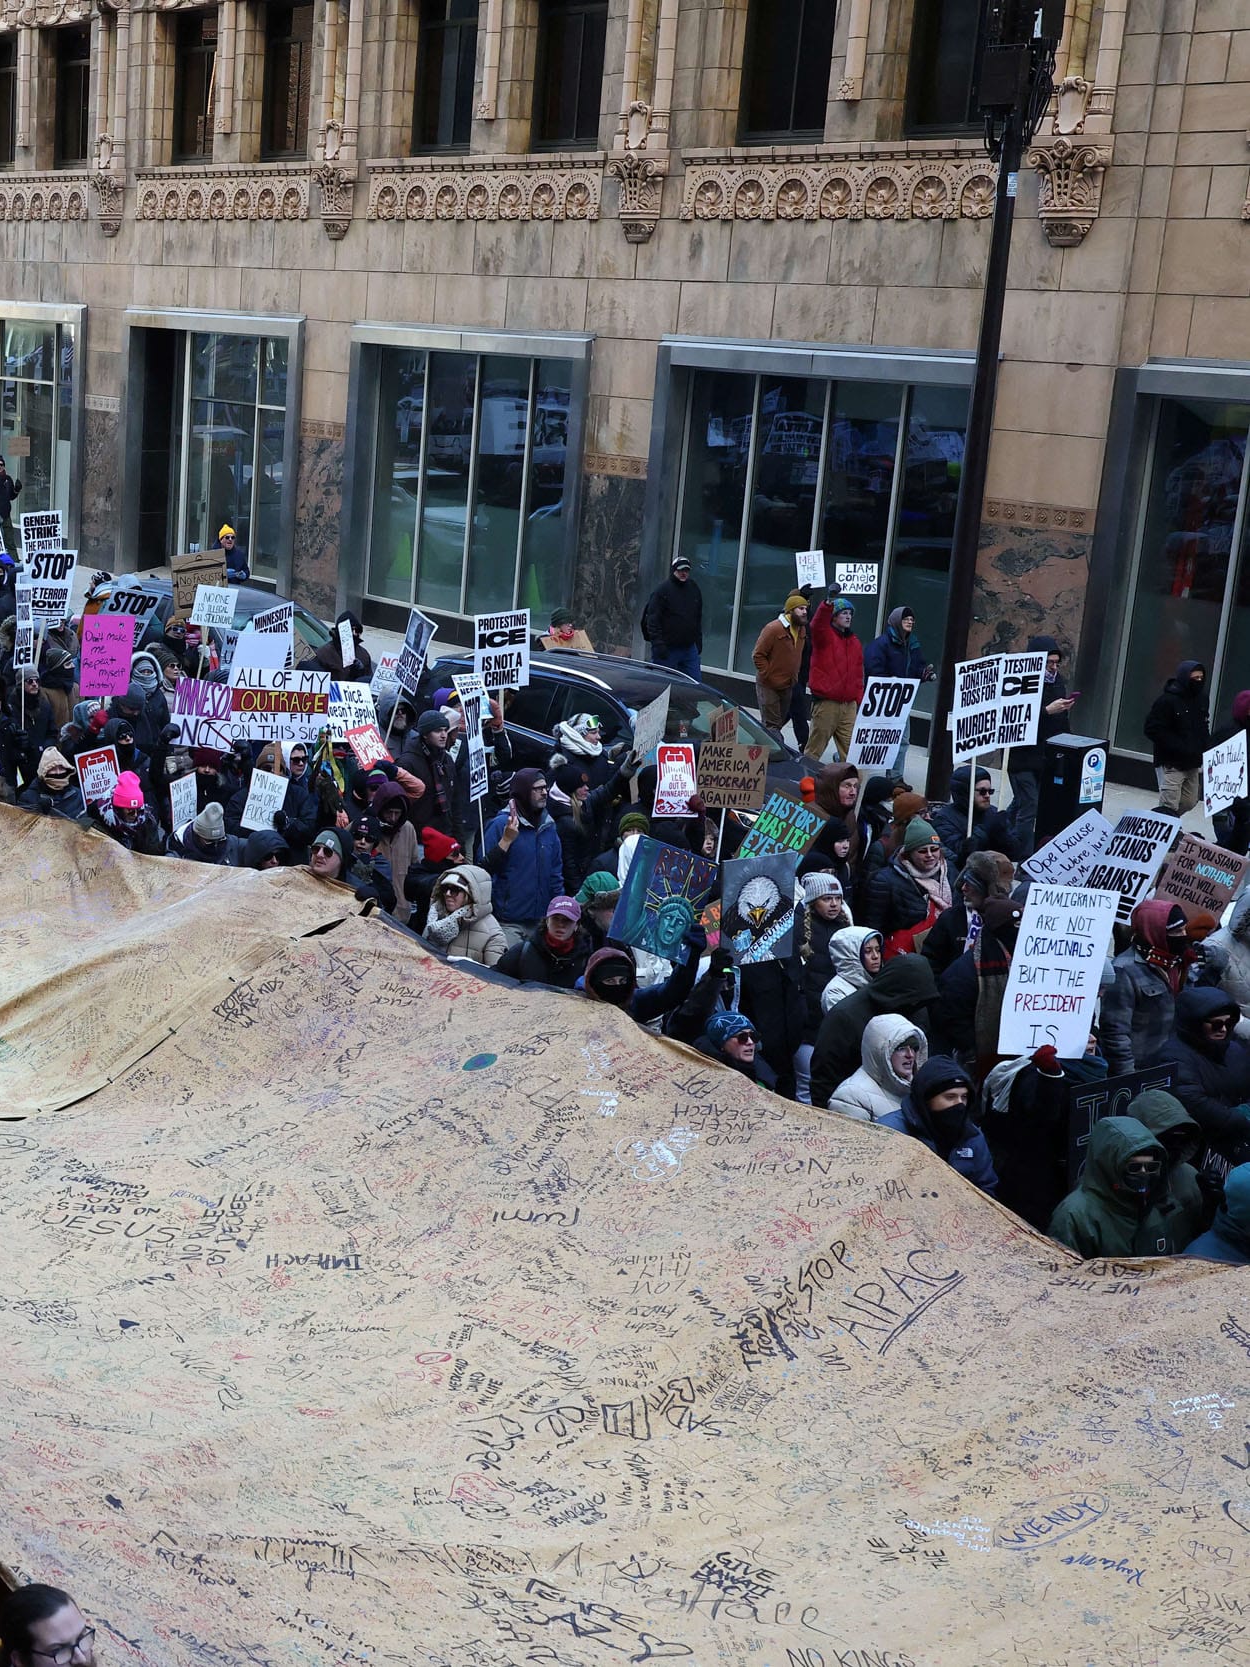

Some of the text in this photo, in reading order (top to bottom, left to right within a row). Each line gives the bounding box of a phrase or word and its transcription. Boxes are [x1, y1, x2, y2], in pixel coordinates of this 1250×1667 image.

[23, 513, 60, 527] GENERAL
[31, 553, 75, 580] STOP
[799, 553, 821, 565] MELT
[846, 564, 874, 574] LIAM
[193, 572, 222, 583] FASCISTS
[841, 582, 877, 593] RAMOS
[39, 587, 68, 600] TERROR
[108, 591, 158, 616] STOP
[254, 606, 293, 629] MINNESOTA
[478, 613, 527, 631] PROTESTING
[85, 631, 104, 642] Don't
[478, 628, 526, 649] ICE
[91, 646, 107, 655] me
[482, 653, 514, 670] IS NOT
[959, 657, 1002, 674] ARREST
[236, 669, 328, 693] ALL OF MY
[484, 669, 519, 687] CRIME!
[960, 667, 999, 692] JONATHAN
[241, 691, 325, 712] OUTRAGE
[862, 682, 914, 717] STOP
[961, 689, 980, 708] ROSS
[290, 713, 313, 723] FIT
[1002, 704, 1021, 723] NOT
[258, 725, 296, 739] THIS
[956, 709, 996, 741] MURDER
[855, 728, 900, 744] ICE TERROR
[955, 733, 996, 753] NOW!
[702, 746, 733, 758] MAKE
[859, 746, 888, 765] NOW!
[700, 759, 750, 773] AMERICA
[698, 775, 759, 790] DEMOCRACY
[700, 791, 751, 806] AGAIN!!!
[764, 793, 827, 836] HISTORY
[754, 811, 810, 849] HAS ITS
[744, 831, 784, 854] EYES
[1027, 822, 1094, 875] Ope Excuse
[1105, 836, 1156, 863] STANDS
[1177, 856, 1195, 869] FOR
[1198, 846, 1243, 872] YOU STAND
[1171, 868, 1214, 896] WHAT WILL
[1030, 889, 1112, 909] IMMIGRANTS
[1164, 882, 1200, 905] YOU FALL
[1036, 914, 1060, 931] ARE
[1024, 936, 1095, 957] CRIMINALS
[1019, 965, 1086, 987] BUT THE
[1014, 993, 1085, 1014] PRESIDENT
[1026, 1024, 1059, 1049] IS
[671, 1103, 786, 1120] RESEARCH
[40, 1214, 182, 1243] JESUS
[266, 1252, 363, 1272] IMPEACH
[798, 1240, 856, 1313] STOP
[827, 1250, 960, 1350] AIPAC
[1000, 1496, 1104, 1546] WENDY
[716, 1552, 780, 1583] GIVE
[786, 1648, 916, 1667] NO KINGS
